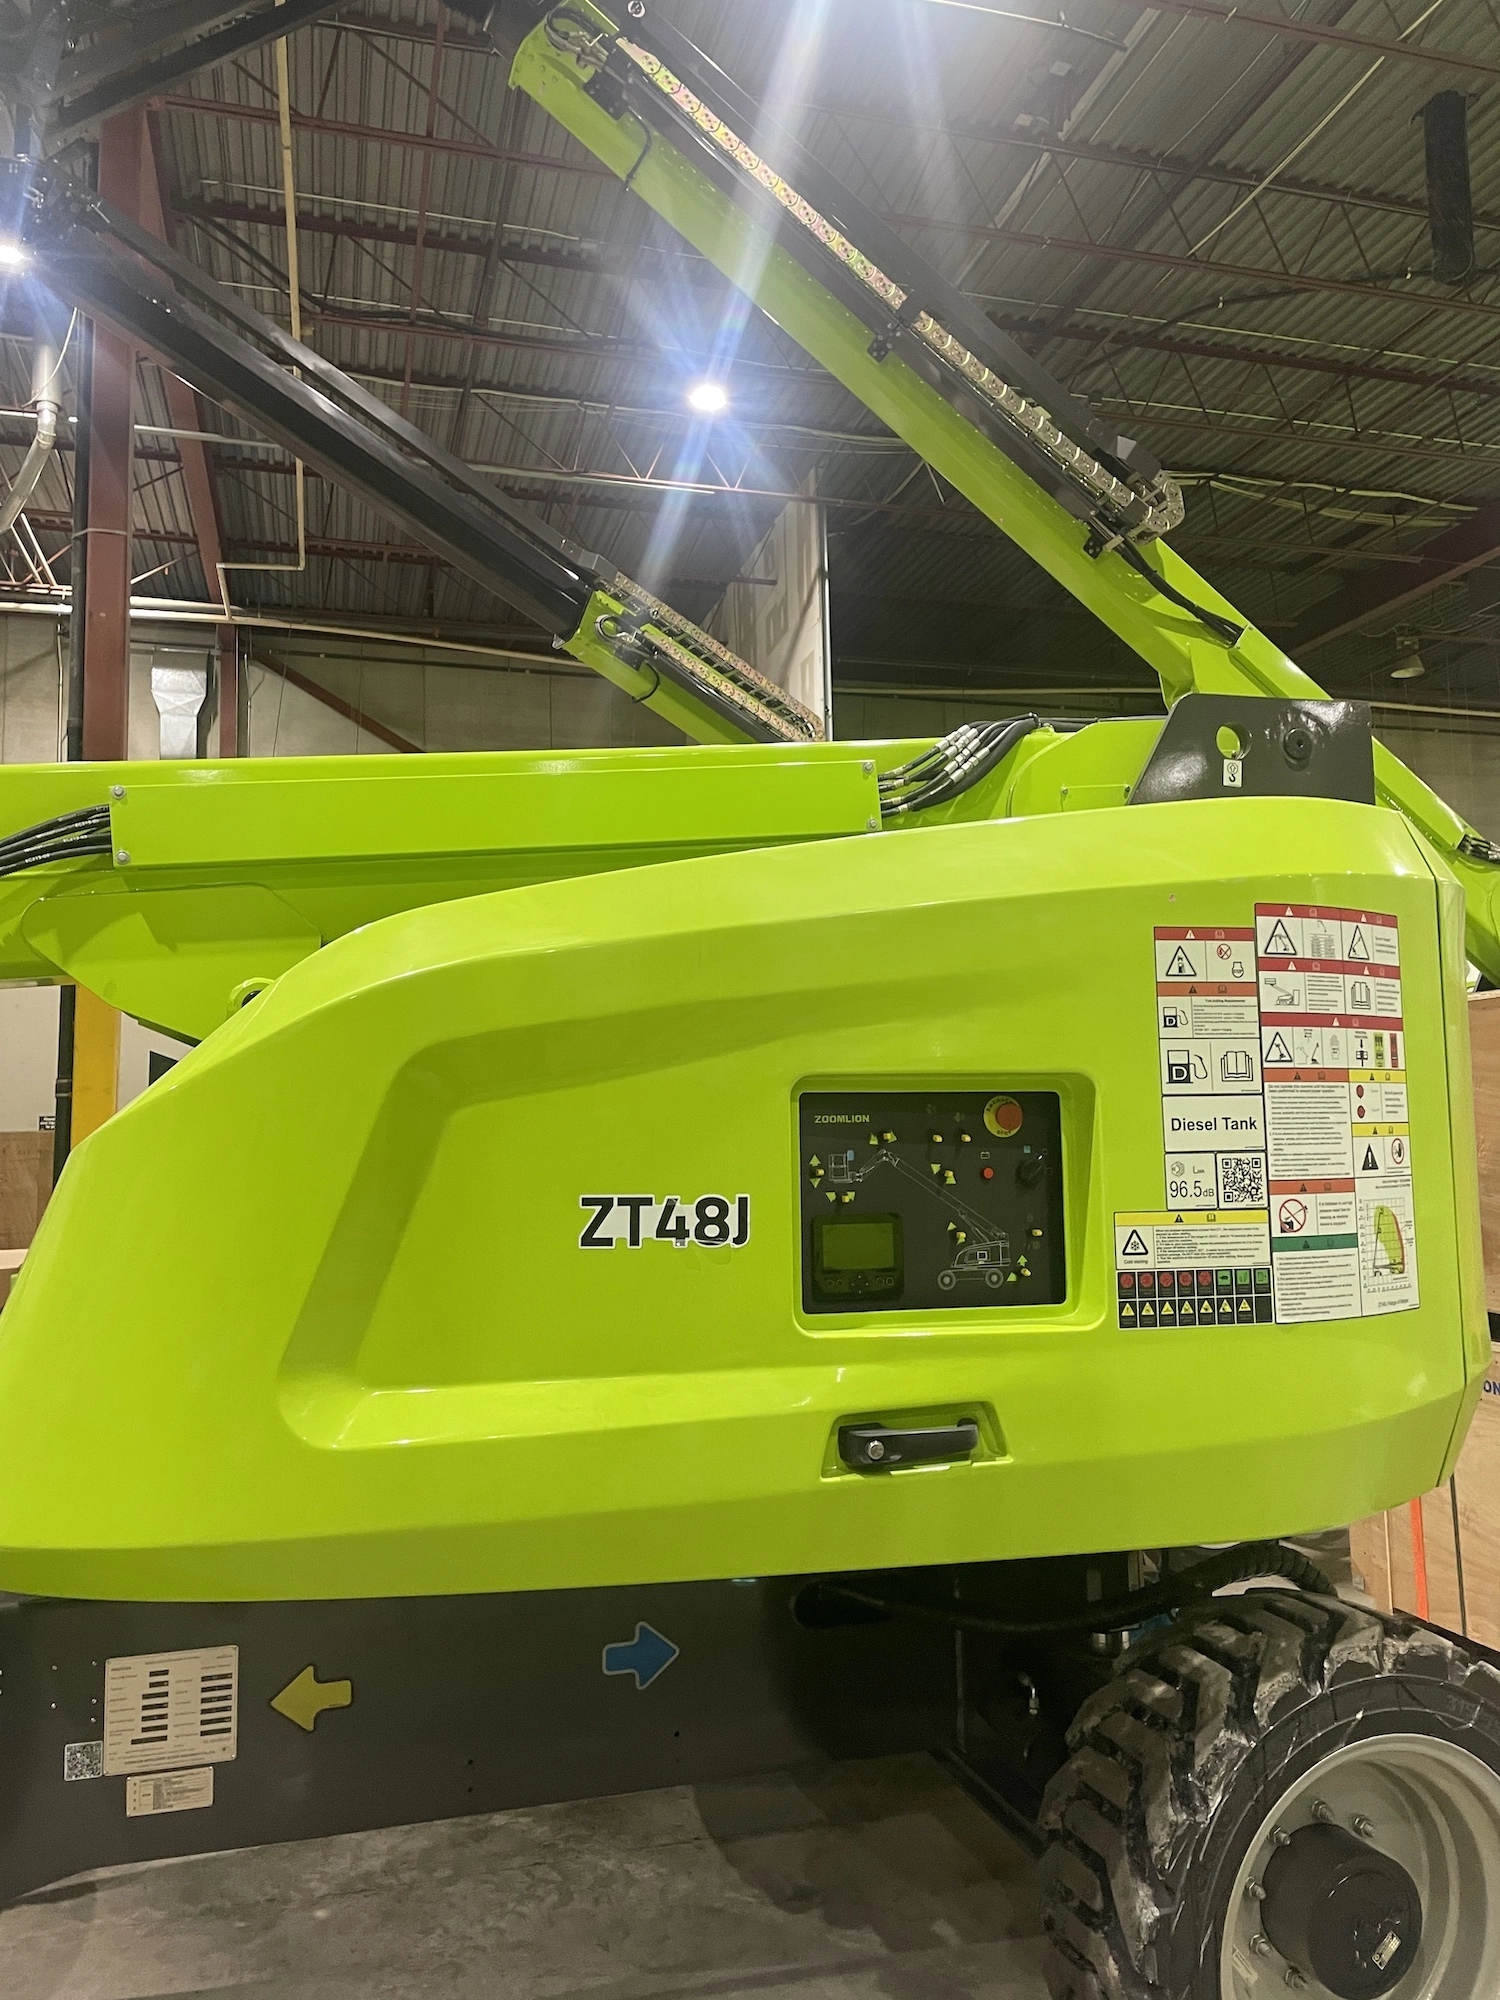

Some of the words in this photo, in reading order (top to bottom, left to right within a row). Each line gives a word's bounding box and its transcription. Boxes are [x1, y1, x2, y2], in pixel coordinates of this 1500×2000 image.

[814, 1115, 870, 1124] ZOOMLION
[1171, 1117, 1217, 1131] Diesel
[1221, 1116, 1257, 1130] Tank
[580, 1195, 750, 1248] ZT48J
